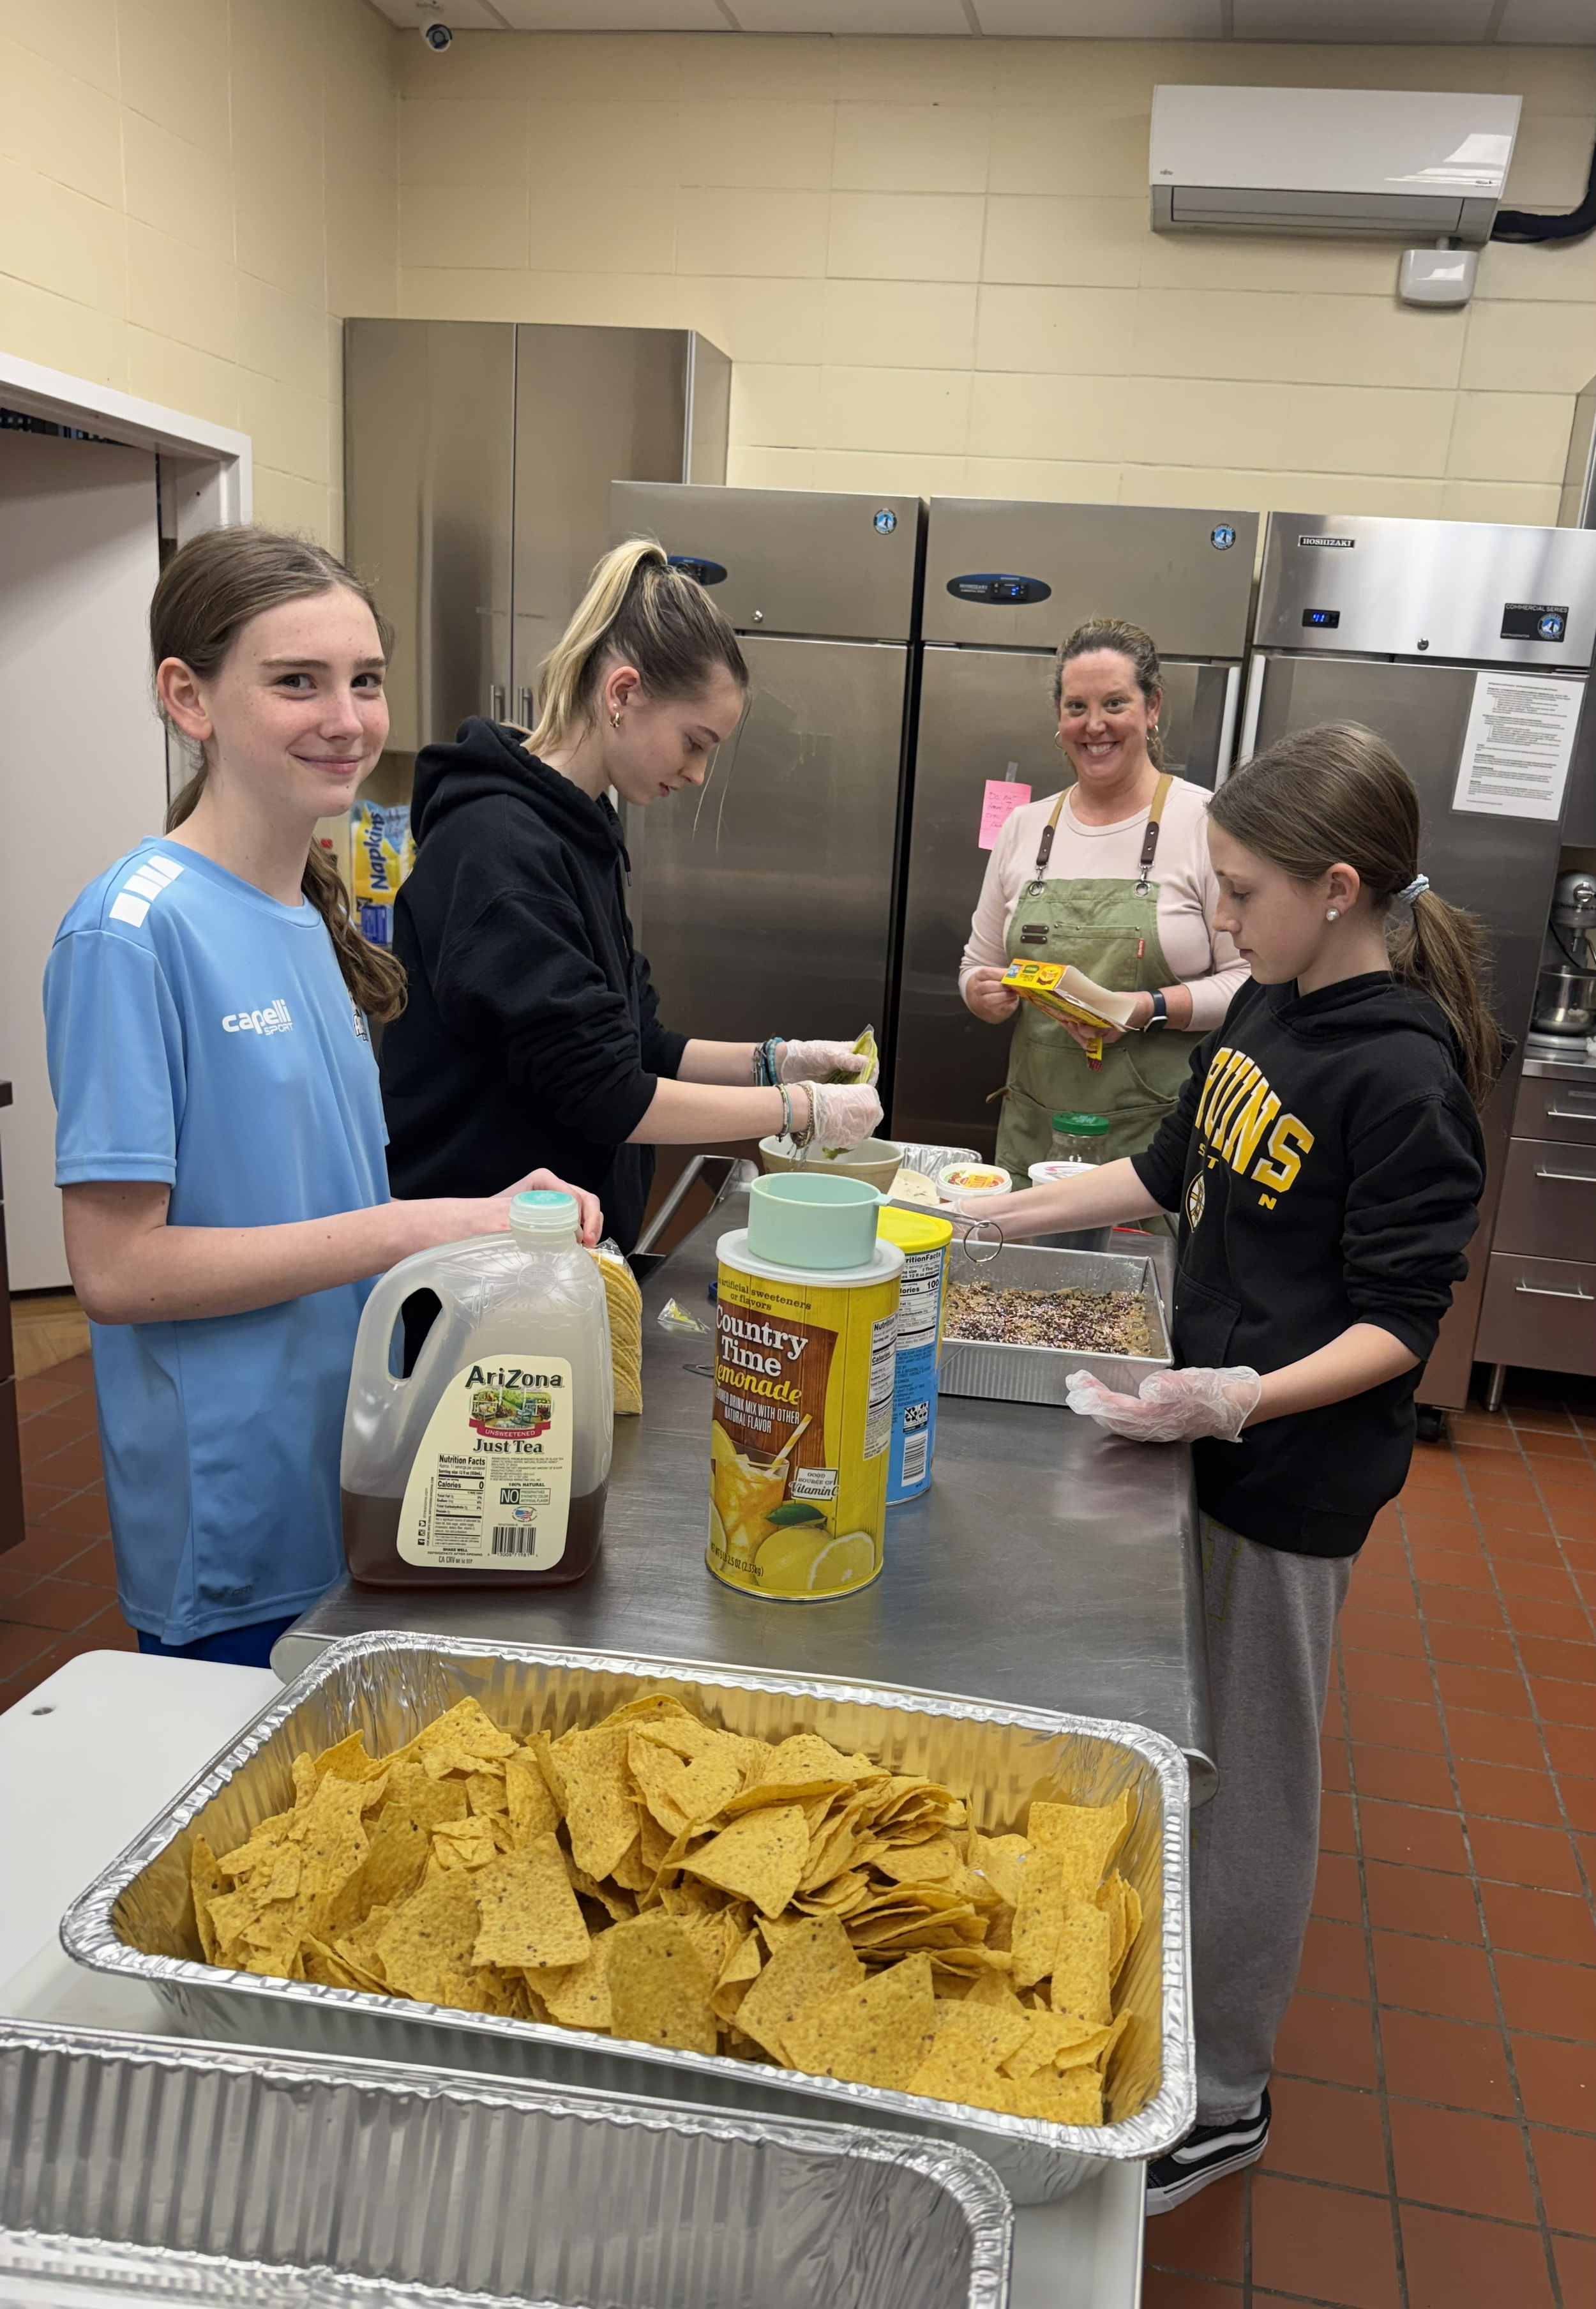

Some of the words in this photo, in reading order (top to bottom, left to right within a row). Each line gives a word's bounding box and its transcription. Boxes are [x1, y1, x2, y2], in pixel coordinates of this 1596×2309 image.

[1302, 538, 1351, 547] HOSHIZAKI
[363, 810, 389, 891] Napkins
[222, 998, 292, 1034] capelli
[264, 1022, 294, 1036] SPORT
[1194, 1047, 1315, 1193] RUINS
[926, 1252, 941, 1261] Facts
[927, 1278, 940, 1289] 100
[721, 1279, 749, 1294] artificial
[751, 1289, 812, 1310] sweeteners
[739, 1294, 772, 1311] flavors
[716, 1304, 809, 1361] Country
[873, 1317, 895, 1332] Nutrition
[721, 1335, 782, 1377] Time
[464, 1365, 563, 1389] AriZona
[729, 1393, 744, 1411] DRINK
[745, 1399, 757, 1416] MIX
[758, 1404, 776, 1420] WITH
[776, 1408, 800, 1425] OTHER
[724, 1405, 746, 1427] NATURAL
[747, 1414, 772, 1434] FLAVOR
[485, 1428, 536, 1437] UNSWEETENED
[473, 1438, 511, 1453] Just
[513, 1440, 545, 1454] Tea
[439, 1454, 467, 1464] Nutrition
[468, 1457, 486, 1465] Facts
[479, 1481, 484, 1490] 0
[789, 1481, 831, 1496] Vitamin
[831, 1485, 839, 1496] C
[501, 1489, 520, 1504] NO
[735, 1558, 741, 1570] OZ
[742, 1561, 764, 1577] (2.33kg)
